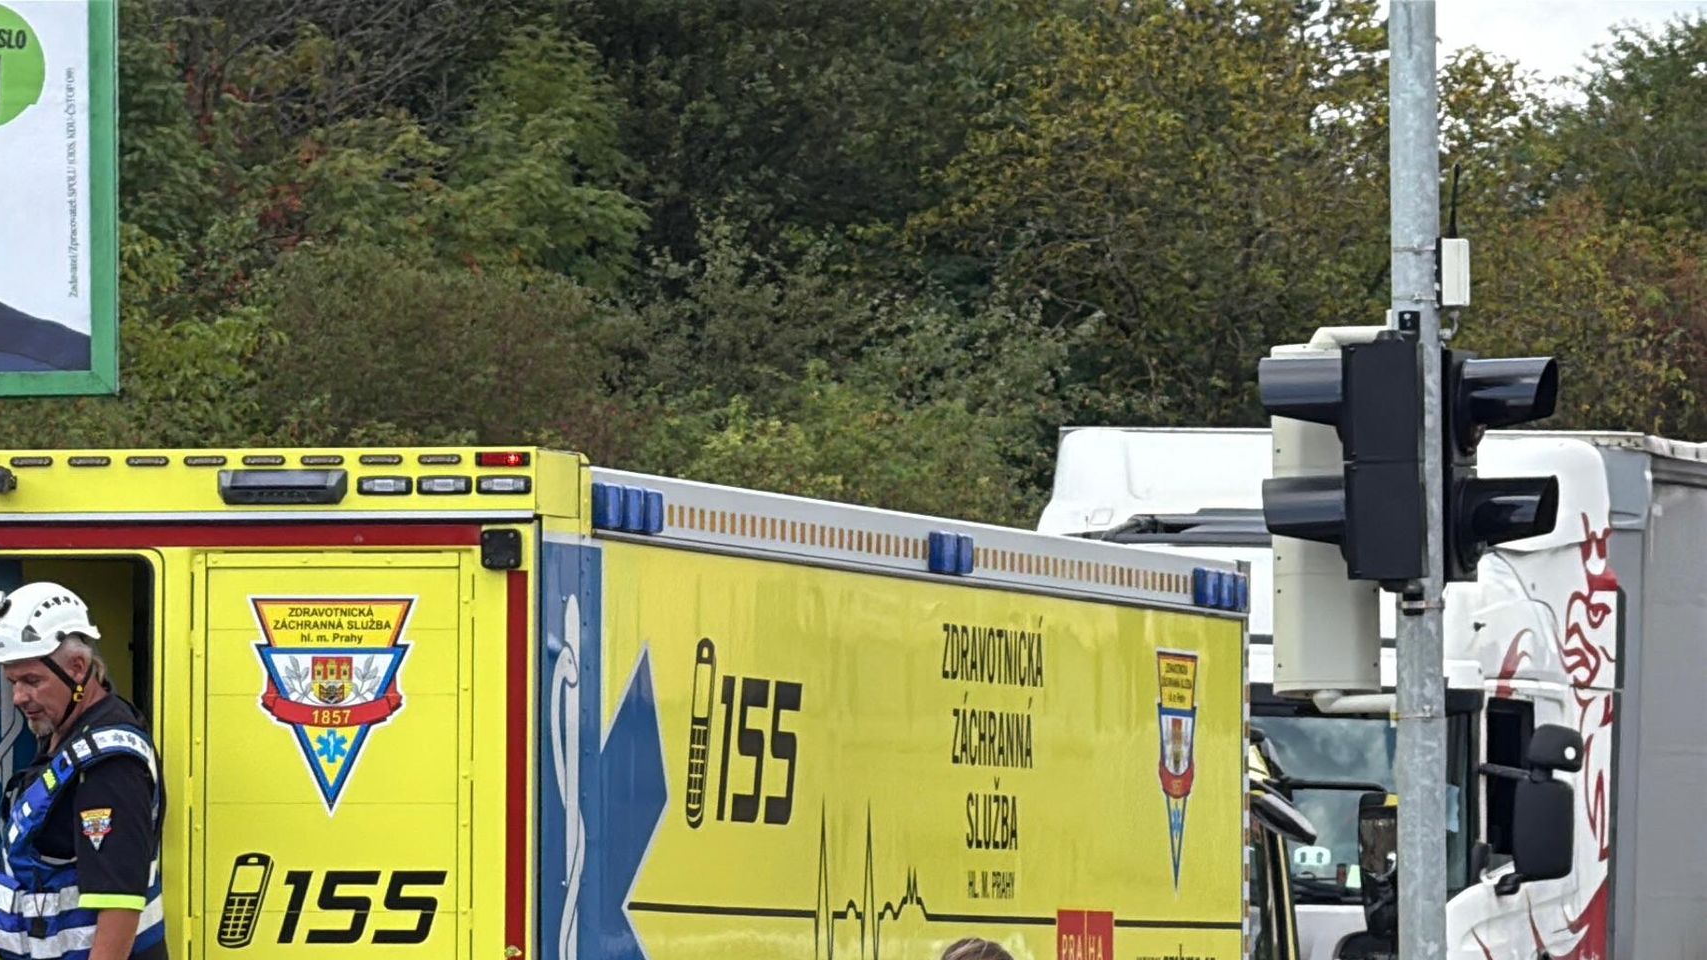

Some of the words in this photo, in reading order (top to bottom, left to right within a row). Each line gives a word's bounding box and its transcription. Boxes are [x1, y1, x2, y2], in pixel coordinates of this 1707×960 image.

[272, 617, 344, 630] ZÁCHRANNÁ
[347, 617, 392, 630] SLUŽBA
[287, 606, 374, 618] ZDRAVOTNICKÁ
[300, 632, 314, 643] hl.
[317, 634, 329, 643] m.
[332, 632, 364, 645] Prahy
[942, 616, 1044, 688] ZDRAVOTNICKÁ
[311, 707, 352, 726] 1857
[716, 675, 802, 825] 155
[951, 692, 1033, 769] ZÁCHRANNÁ
[966, 777, 1018, 851] SLUŽBA
[277, 870, 448, 944] 155
